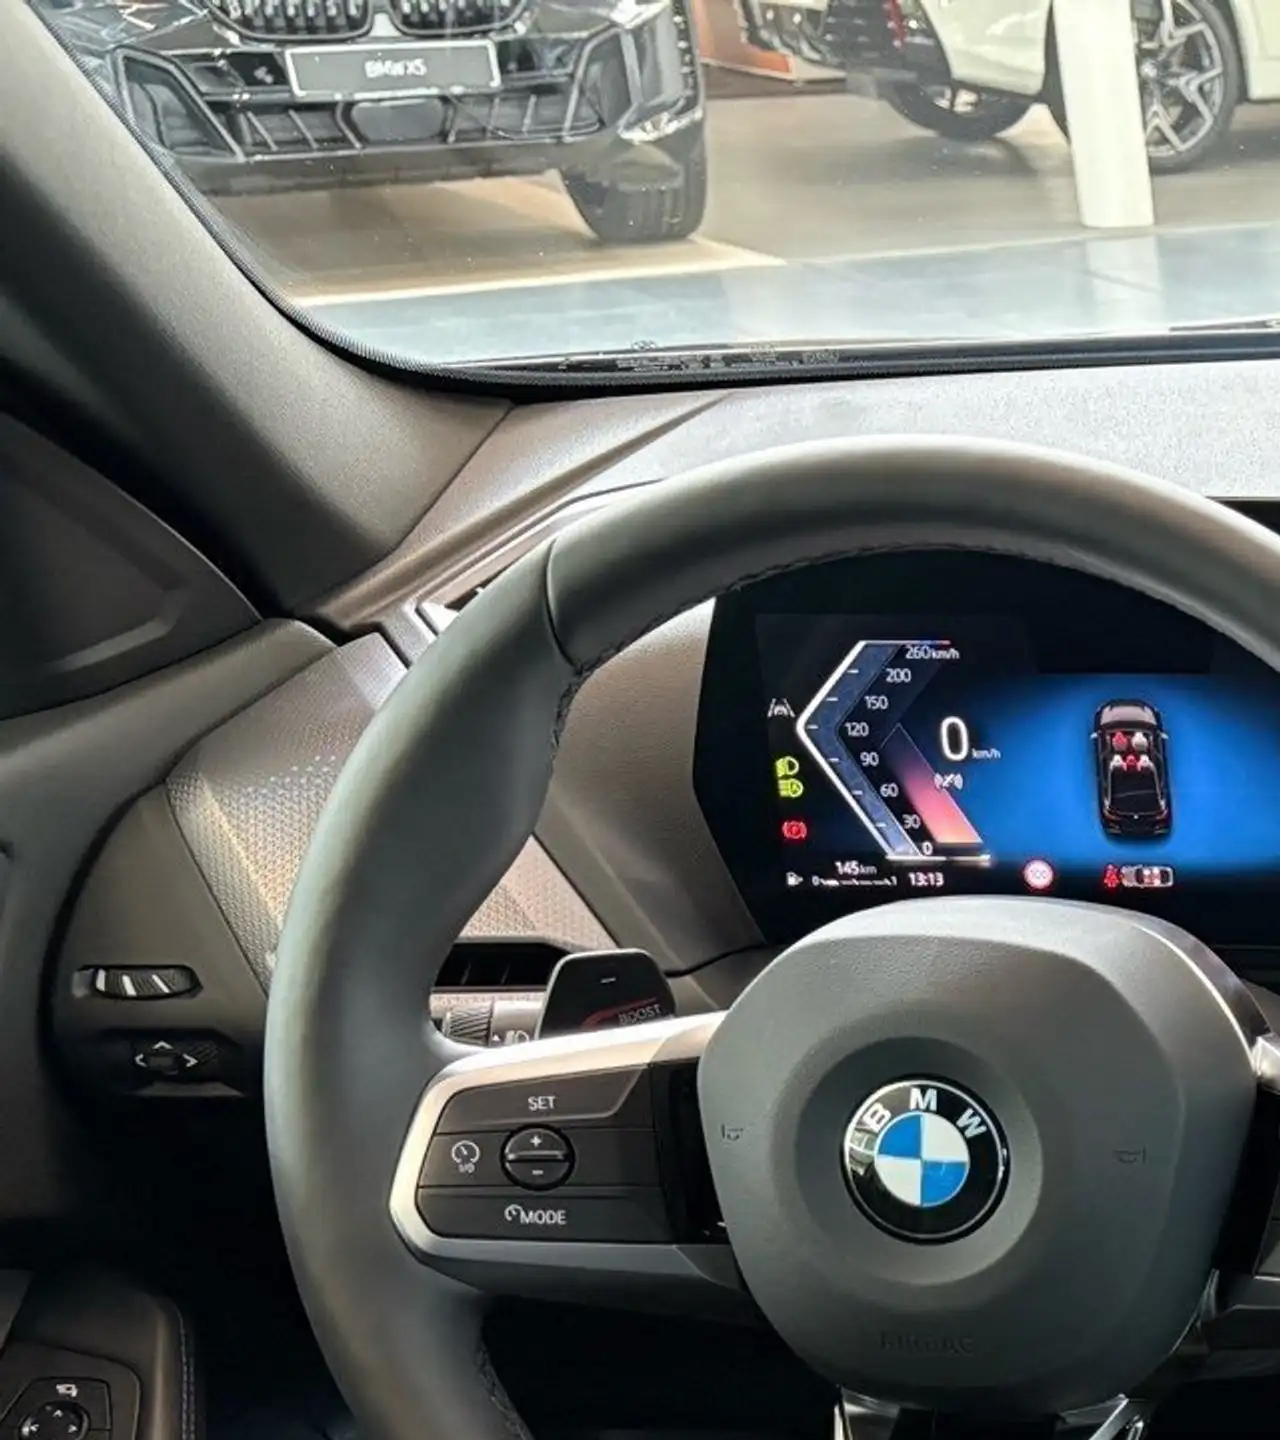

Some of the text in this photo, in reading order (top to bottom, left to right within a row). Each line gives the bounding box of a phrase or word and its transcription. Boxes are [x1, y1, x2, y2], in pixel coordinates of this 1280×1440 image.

[886, 668, 911, 682] 200
[865, 696, 888, 710] 150
[845, 722, 869, 736] 120
[940, 717, 969, 760] 0
[860, 752, 879, 767] 90
[880, 783, 899, 797] 60
[903, 814, 920, 828] 30
[923, 842, 933, 855] 0
[908, 872, 944, 887] 13:13
[528, 1096, 555, 1111] SET
[861, 1088, 988, 1138] BMW
[521, 1210, 566, 1225] MODE
